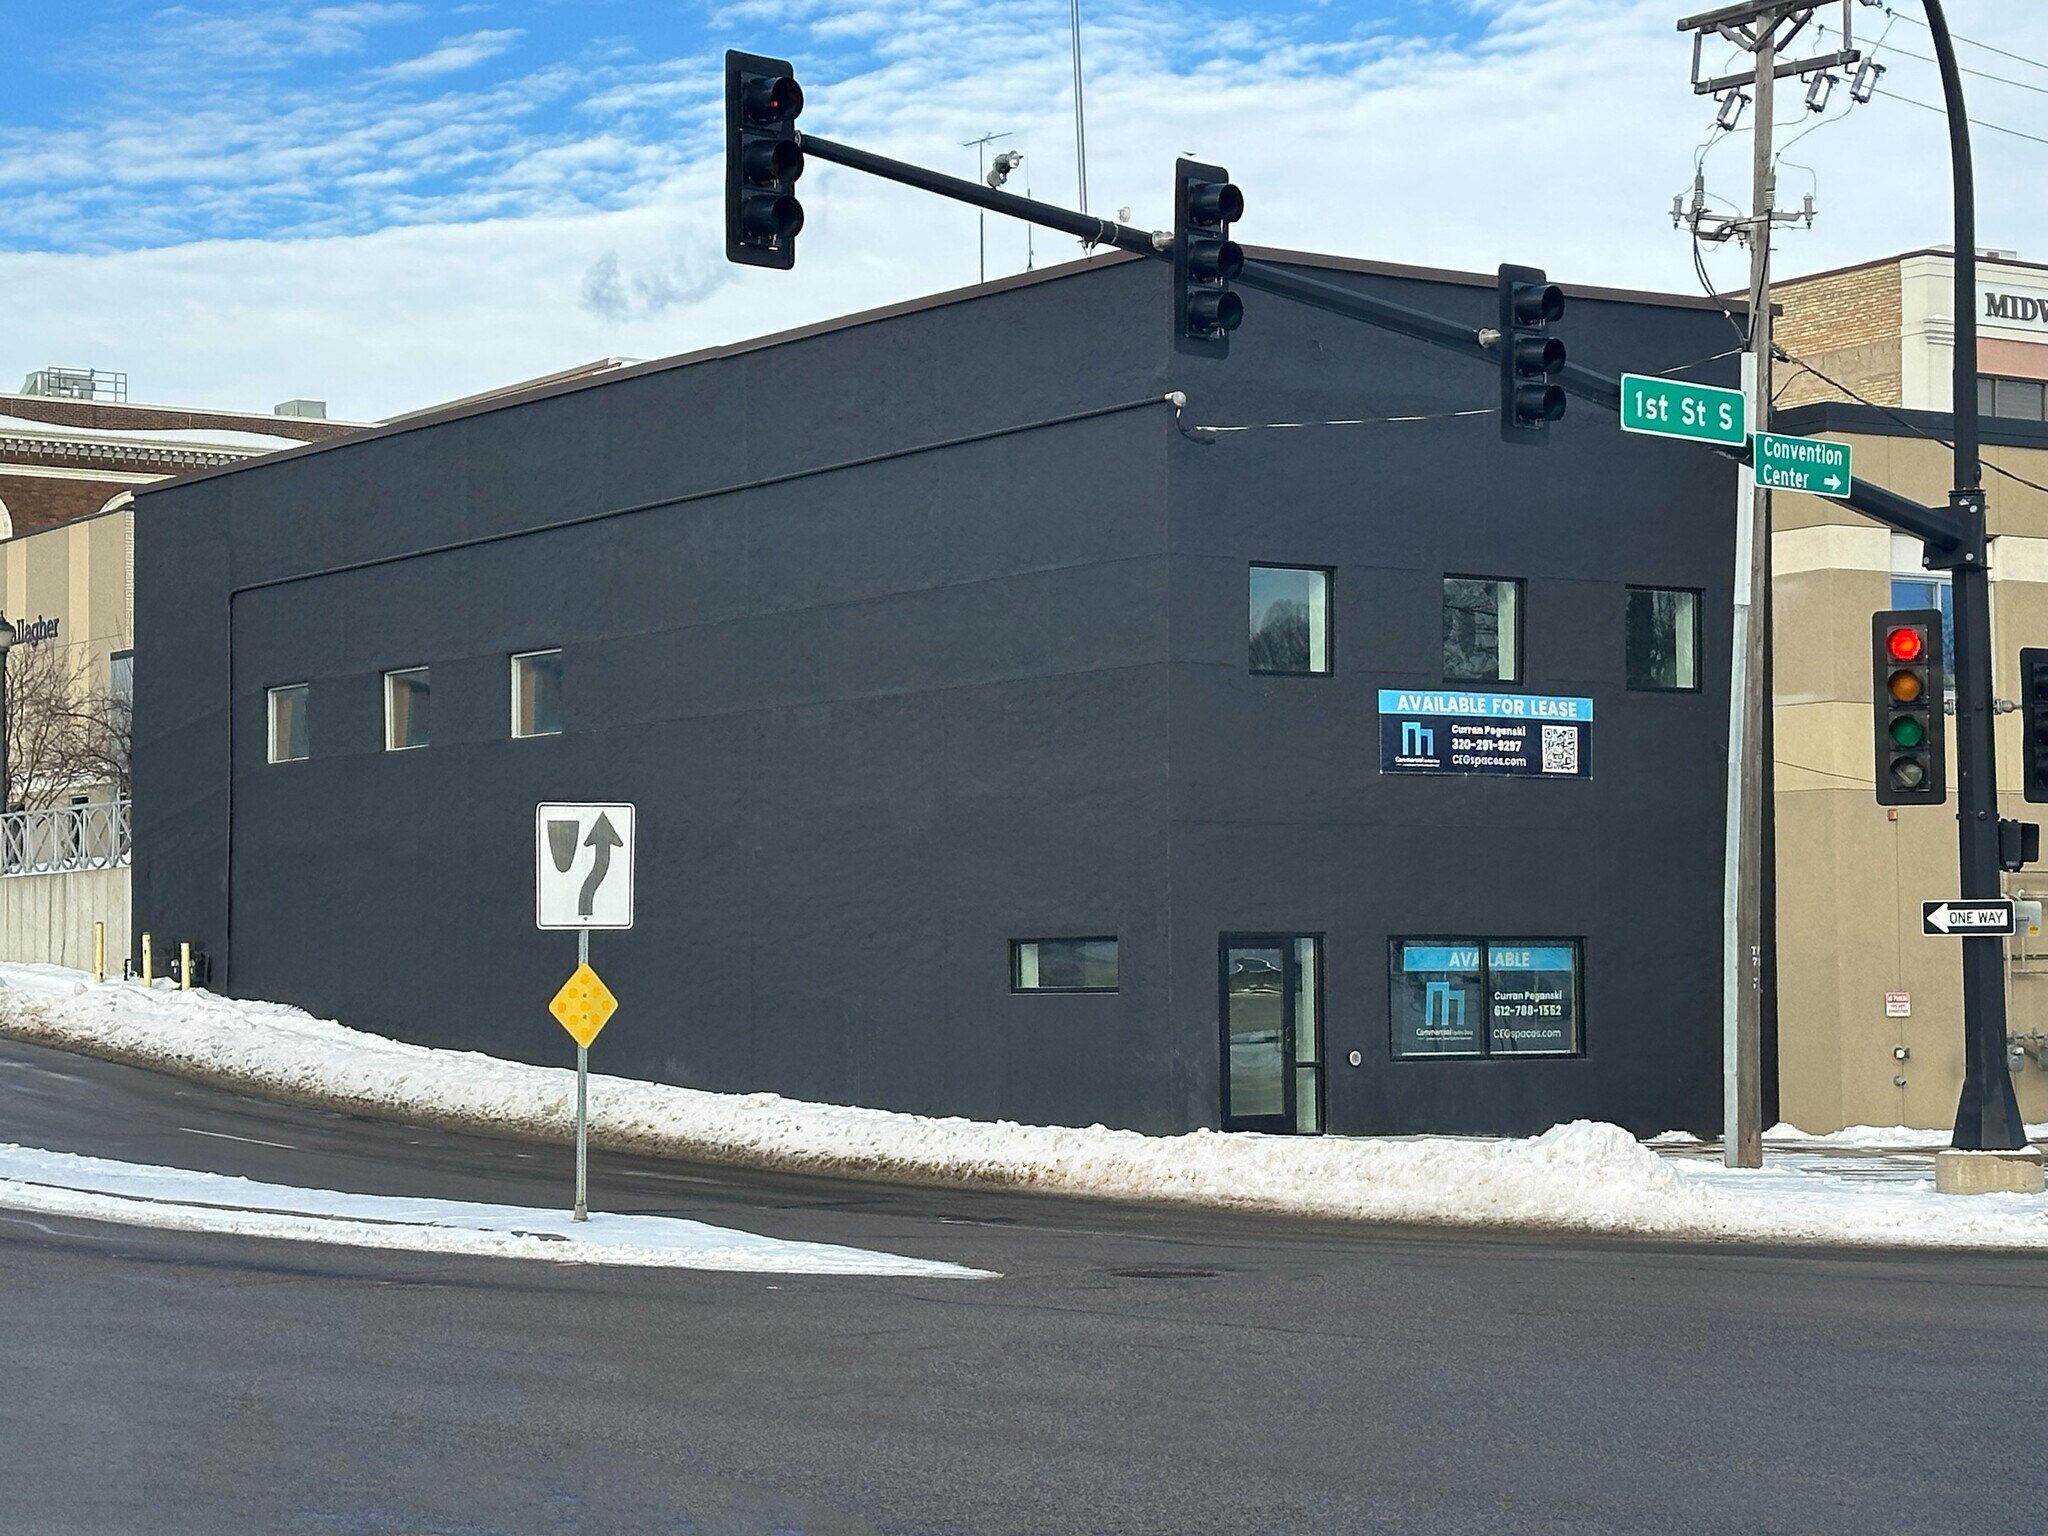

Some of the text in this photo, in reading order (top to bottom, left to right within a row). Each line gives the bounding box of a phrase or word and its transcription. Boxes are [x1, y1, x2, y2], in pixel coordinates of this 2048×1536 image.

[1635, 390, 1733, 431] 1st St S
[1764, 436, 1843, 467] Convention
[1763, 465, 1810, 489] Center
[1397, 694, 1577, 718] AVAILABLE FOR LEASE
[1451, 724, 1484, 735] Curran
[1949, 911, 2004, 924] ONE WAY
[1448, 951, 1530, 967] AVALABLE
[1494, 991, 1524, 1000] Curran
